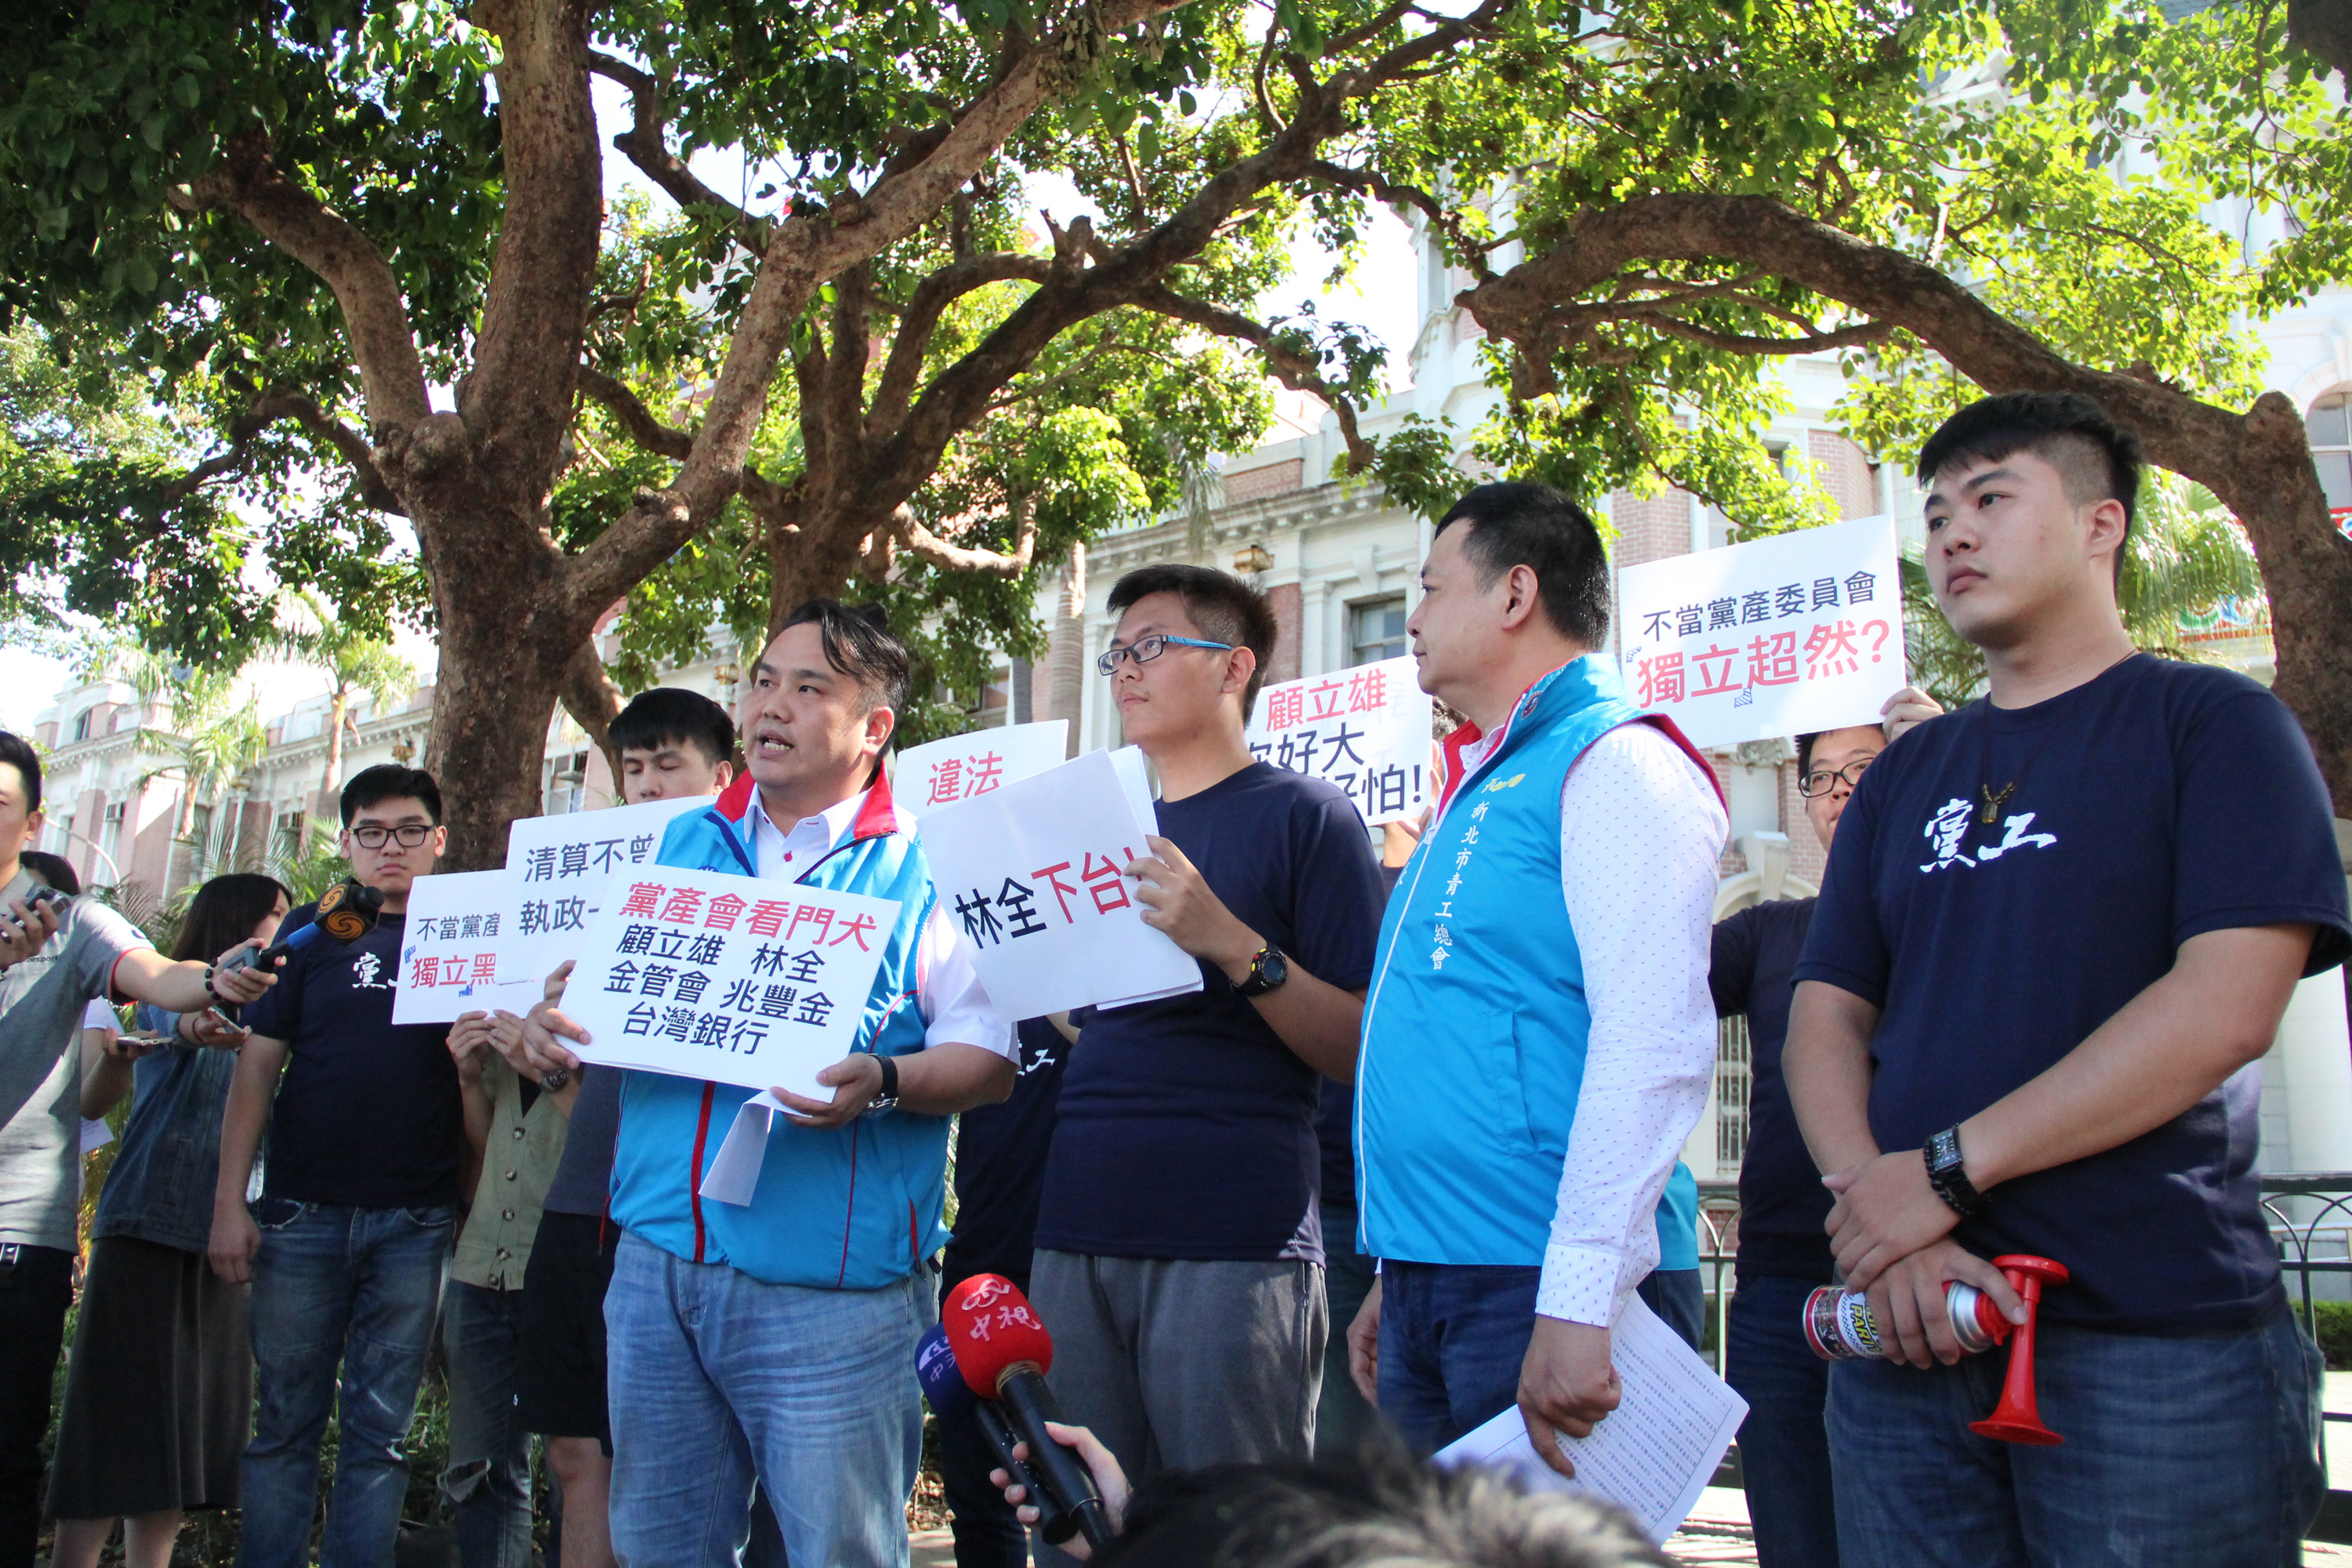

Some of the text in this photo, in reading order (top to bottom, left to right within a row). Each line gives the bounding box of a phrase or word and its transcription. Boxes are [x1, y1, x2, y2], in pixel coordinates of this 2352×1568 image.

[1642, 571, 1877, 642] 不當黨產委員會
[1637, 619, 1890, 709] 獨立超然?
[1266, 668, 1388, 732] 顧立雄
[926, 750, 1004, 807] 違法
[1920, 798, 2057, 873] 黨工
[1429, 800, 1490, 971] 新北市青工總會
[416, 913, 501, 942] 不當黨產
[618, 881, 877, 953] 黨產會看門犬
[352, 951, 398, 989] 黨
[411, 953, 496, 989] 獨立黑
[615, 924, 826, 984] 顧立雄 林全
[603, 960, 835, 1027] 金管會 兆豐金
[622, 1000, 771, 1055] 台灣銀行
[970, 1305, 1042, 1341] 中視
